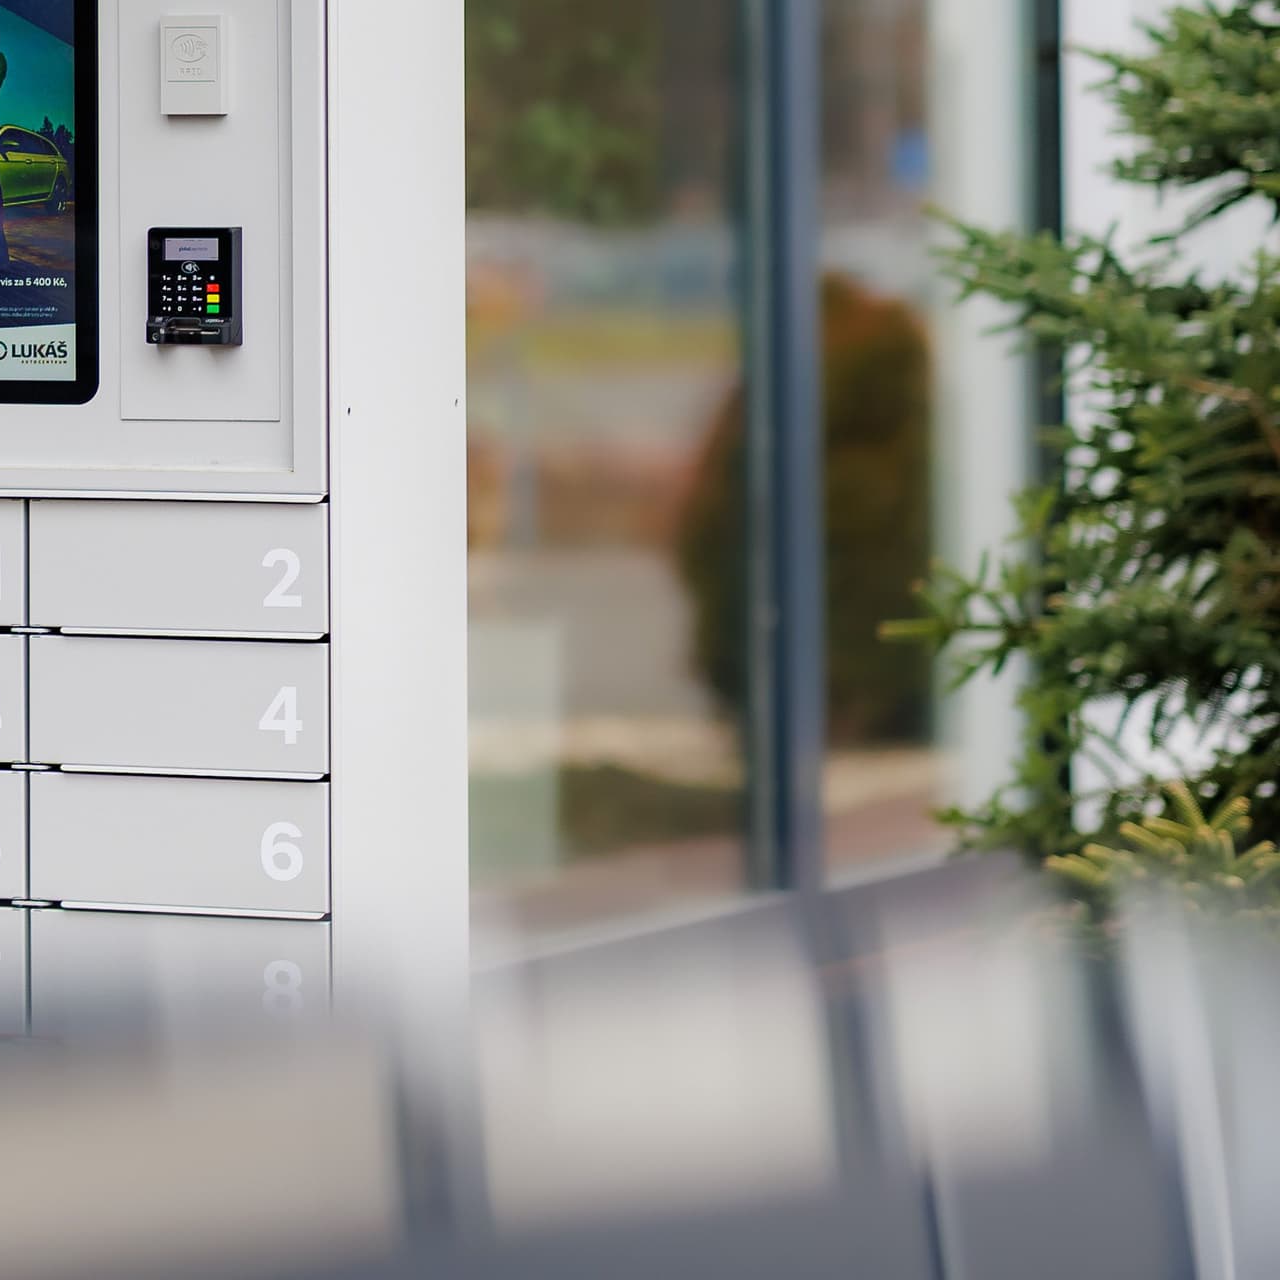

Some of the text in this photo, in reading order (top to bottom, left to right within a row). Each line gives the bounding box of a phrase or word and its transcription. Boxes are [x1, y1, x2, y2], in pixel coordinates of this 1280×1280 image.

[14, 279, 24, 287] za
[33, 277, 52, 287] 400
[53, 277, 68, 288] Kč,
[11, 340, 68, 358] LUKÁŠ
[261, 548, 303, 608] 2
[258, 686, 304, 745] 4
[260, 821, 305, 881] 6
[262, 959, 304, 1017] 8
